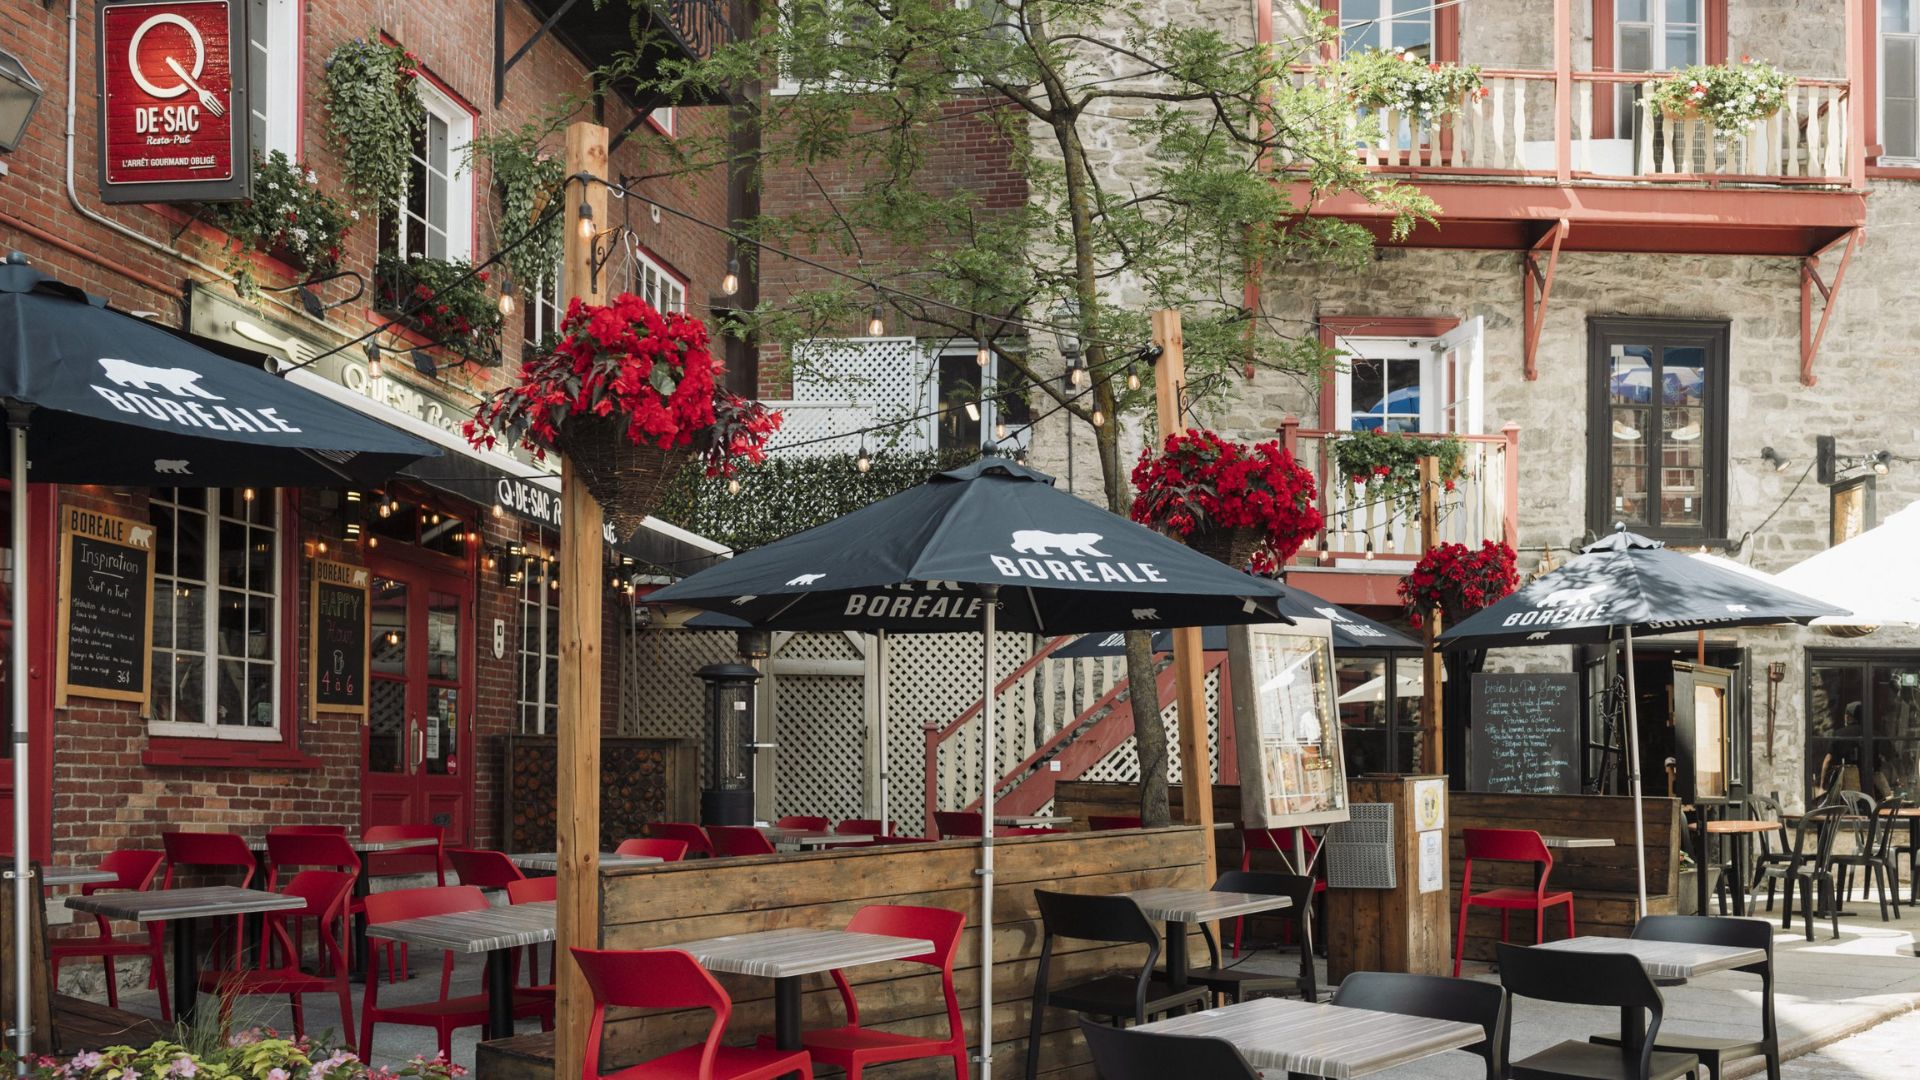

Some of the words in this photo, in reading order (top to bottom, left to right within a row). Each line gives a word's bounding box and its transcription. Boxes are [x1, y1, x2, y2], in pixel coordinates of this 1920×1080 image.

[122, 157, 149, 168] L'ARRÊT
[151, 157, 189, 167] GOURMAND
[191, 155, 216, 165] OBLIGÉ
[90, 384, 302, 432] BORÉALE
[71, 510, 123, 541] BORÉALE
[81, 543, 139, 574] Inspiration
[990, 554, 1168, 583] BORÉALE
[87, 576, 105, 593] Surf
[320, 590, 360, 621] HAPPY
[844, 594, 984, 619] BORÉALE
[322, 670, 330, 692] 4
[346, 675, 353, 693] 6
